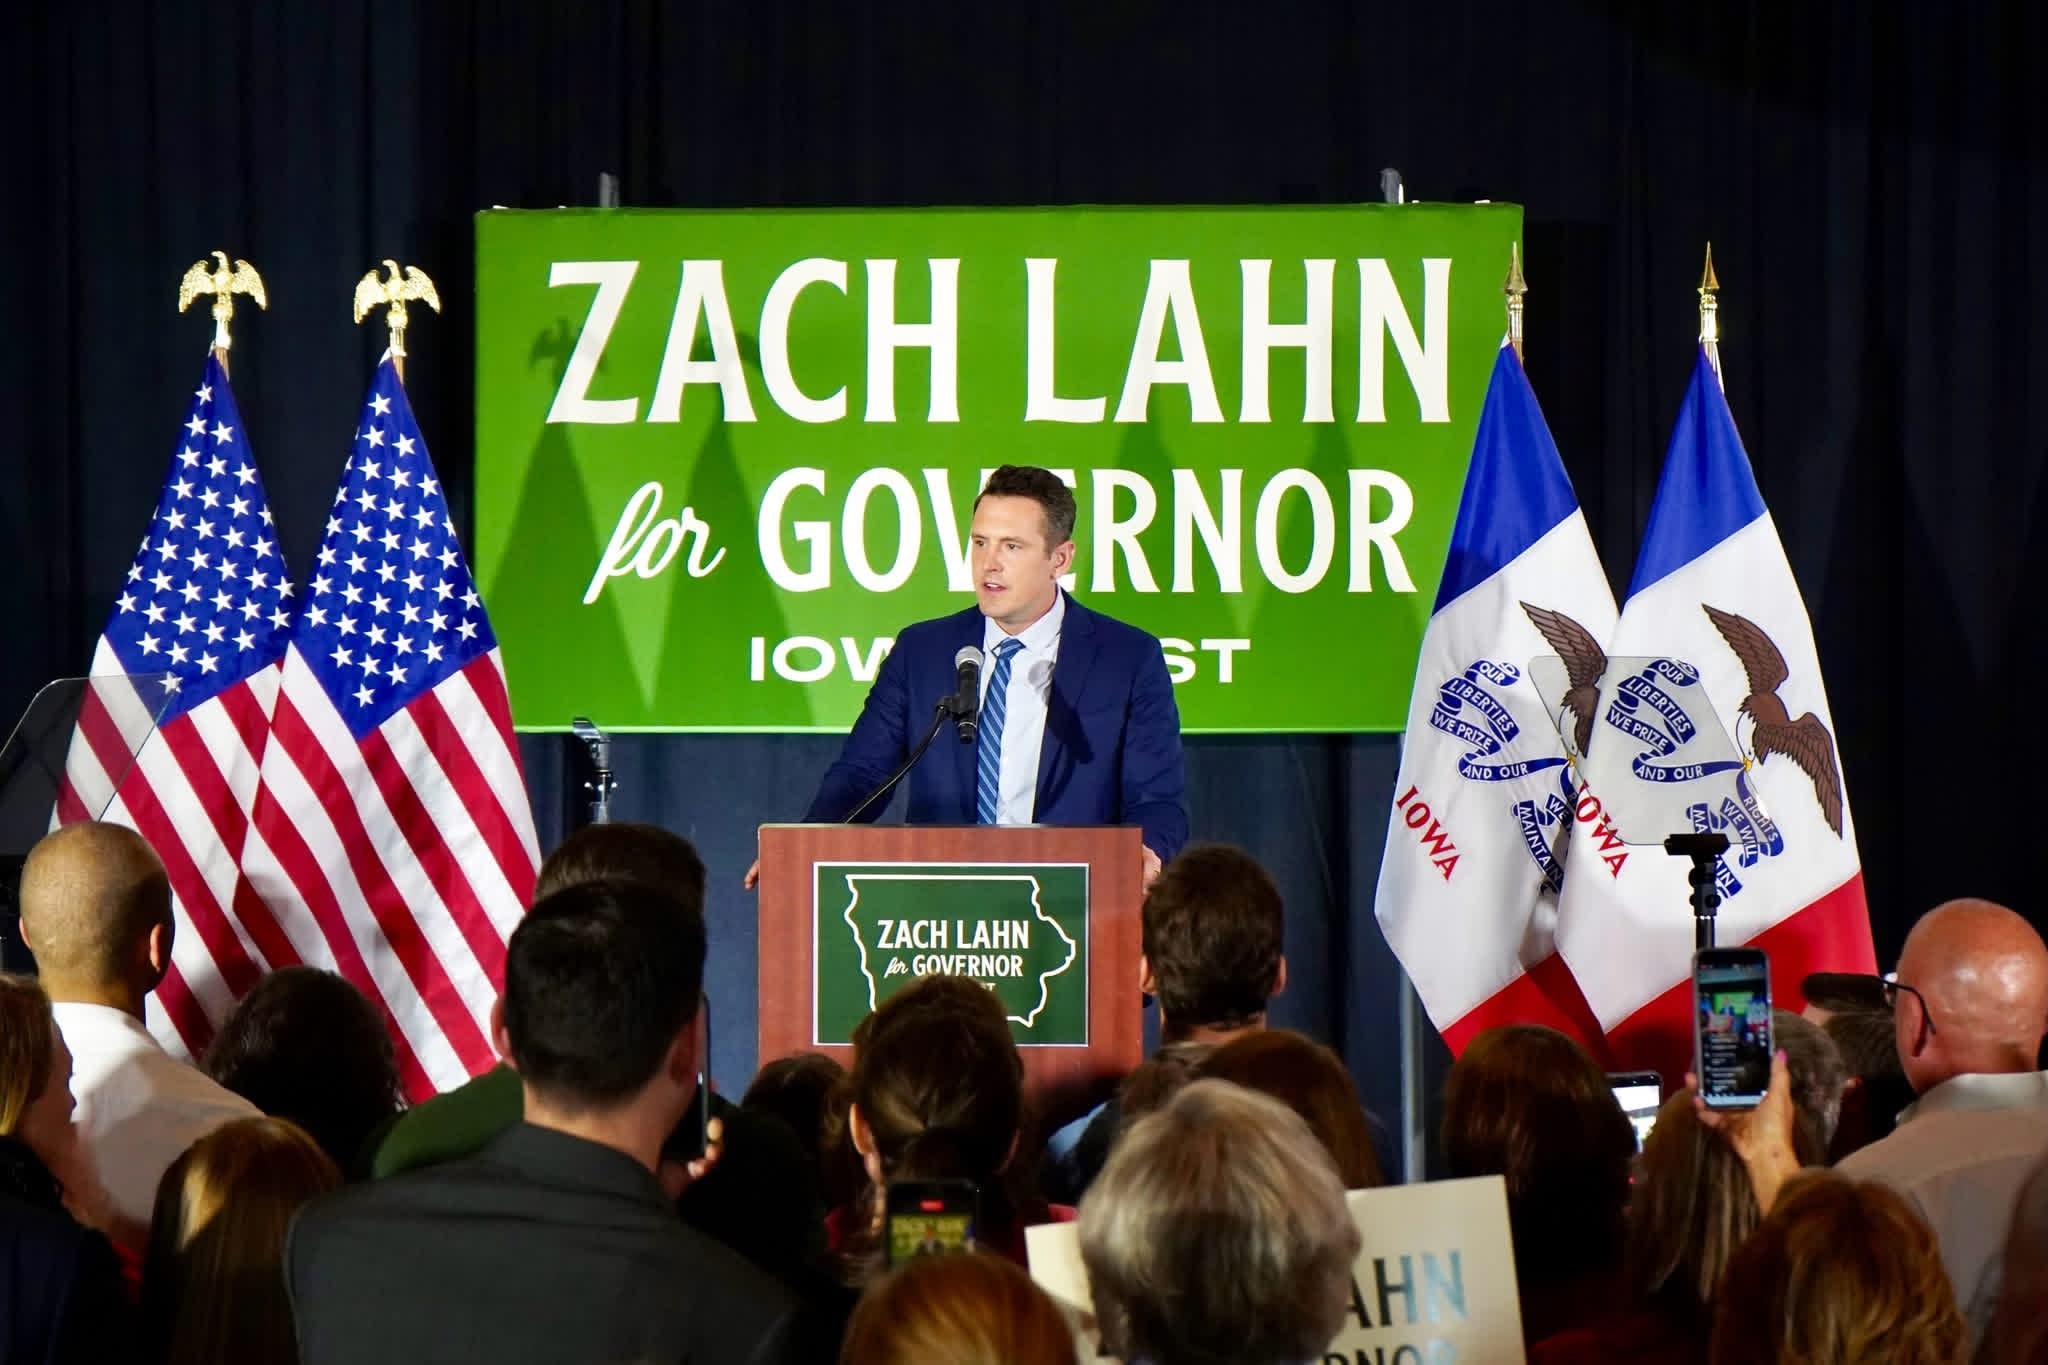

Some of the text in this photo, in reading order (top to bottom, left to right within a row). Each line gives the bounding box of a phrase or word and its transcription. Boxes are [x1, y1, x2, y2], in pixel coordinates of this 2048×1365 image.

[546, 257, 1452, 424] ZACH LAHN
[583, 467, 1418, 604] for GOVRNOR
[751, 636, 895, 682] IOW
[1480, 662, 1505, 684] OUR
[1658, 661, 1684, 684] OUR
[1447, 680, 1515, 732] LIBERTIES
[1626, 678, 1691, 733] LIBERTIES
[1434, 711, 1493, 750] WE PRIZE
[1609, 709, 1668, 751] WE PRIZE
[1462, 763, 1528, 779] AND OUR
[1635, 764, 1703, 780] AND OUR
[1397, 785, 1461, 881] IOWA
[1723, 801, 1758, 859] WE WILL
[1743, 797, 1778, 842] RIGHTS
[877, 920, 1029, 949] ZACH LAHN
[884, 955, 1024, 978] for GOVERNOR
